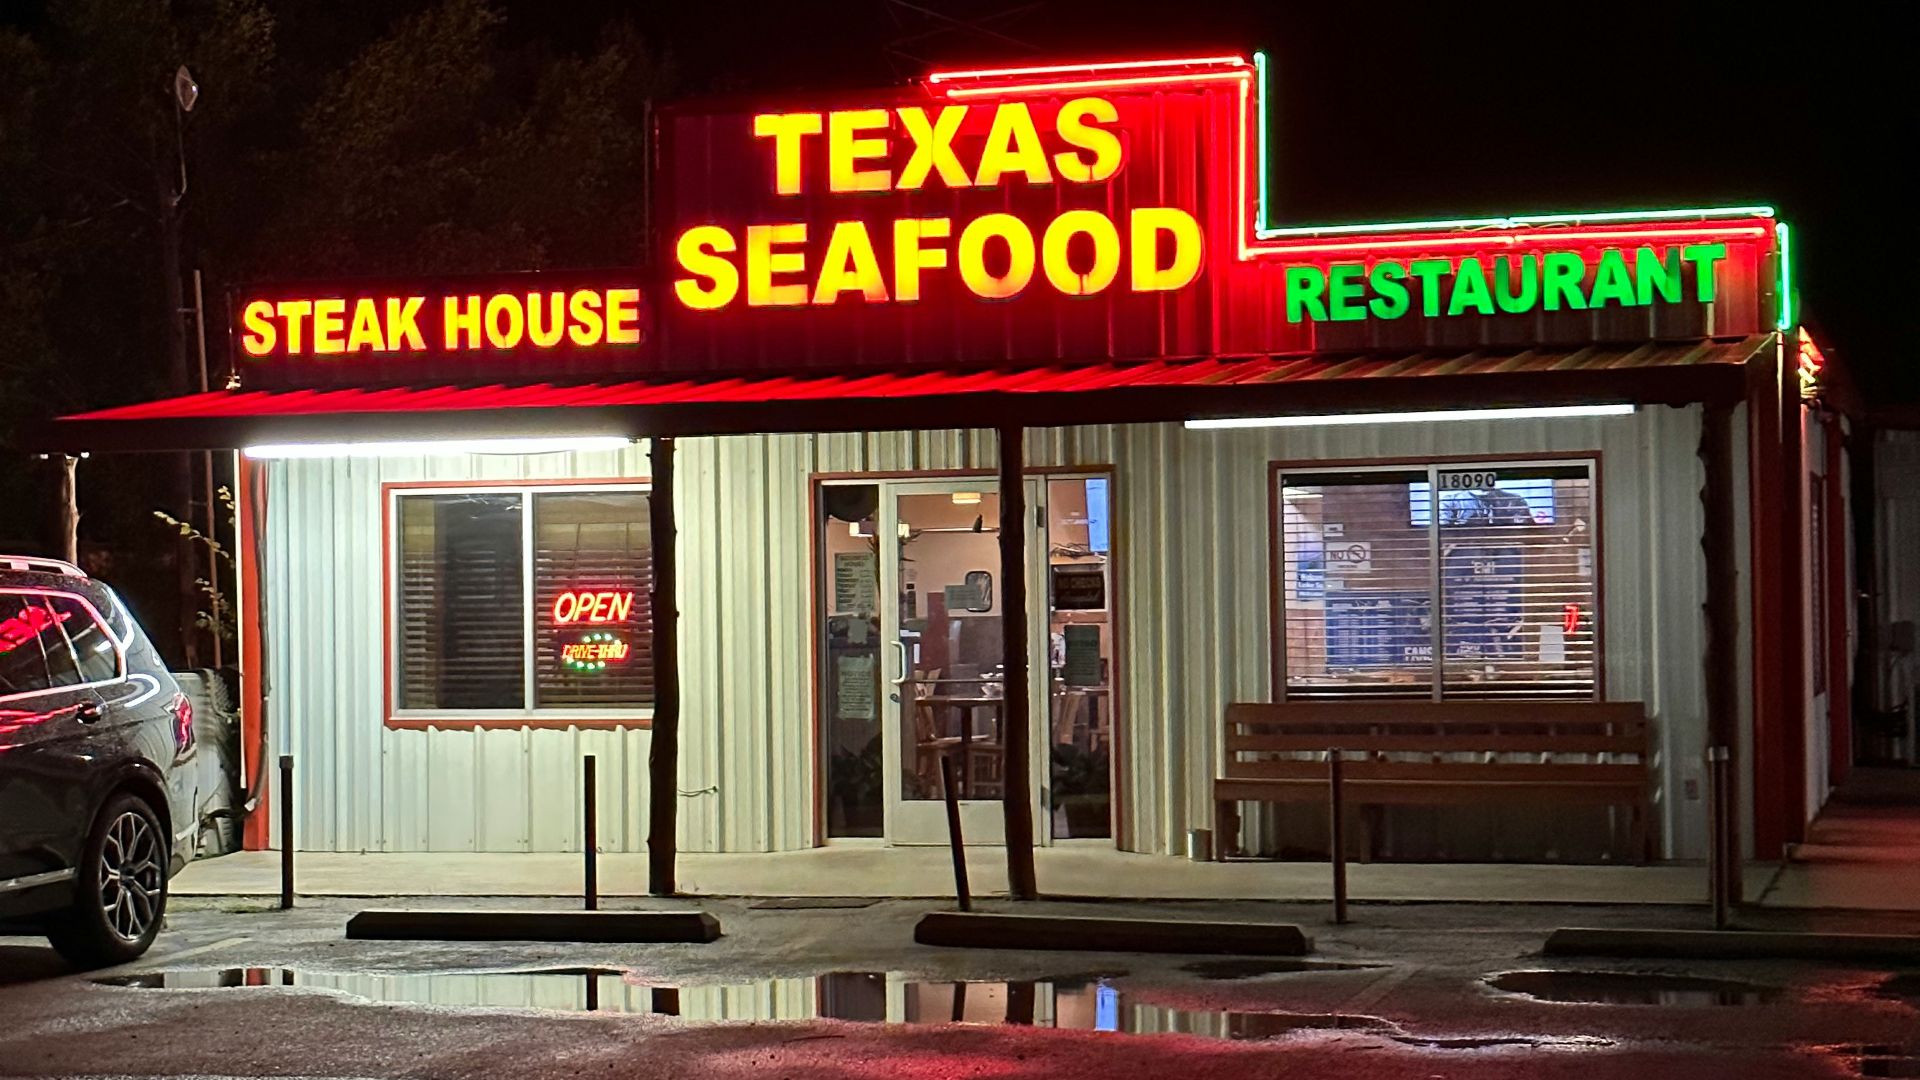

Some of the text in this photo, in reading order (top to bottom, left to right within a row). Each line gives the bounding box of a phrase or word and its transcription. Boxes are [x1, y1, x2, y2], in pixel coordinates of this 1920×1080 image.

[754, 98, 1122, 194] TEXAS
[674, 207, 1203, 310] SEAFOOD
[1286, 244, 1726, 322] RESTAURANT
[242, 288, 641, 355] STEAK HOUSE
[1441, 473, 1496, 488] 18090
[554, 592, 632, 622] OPEN
